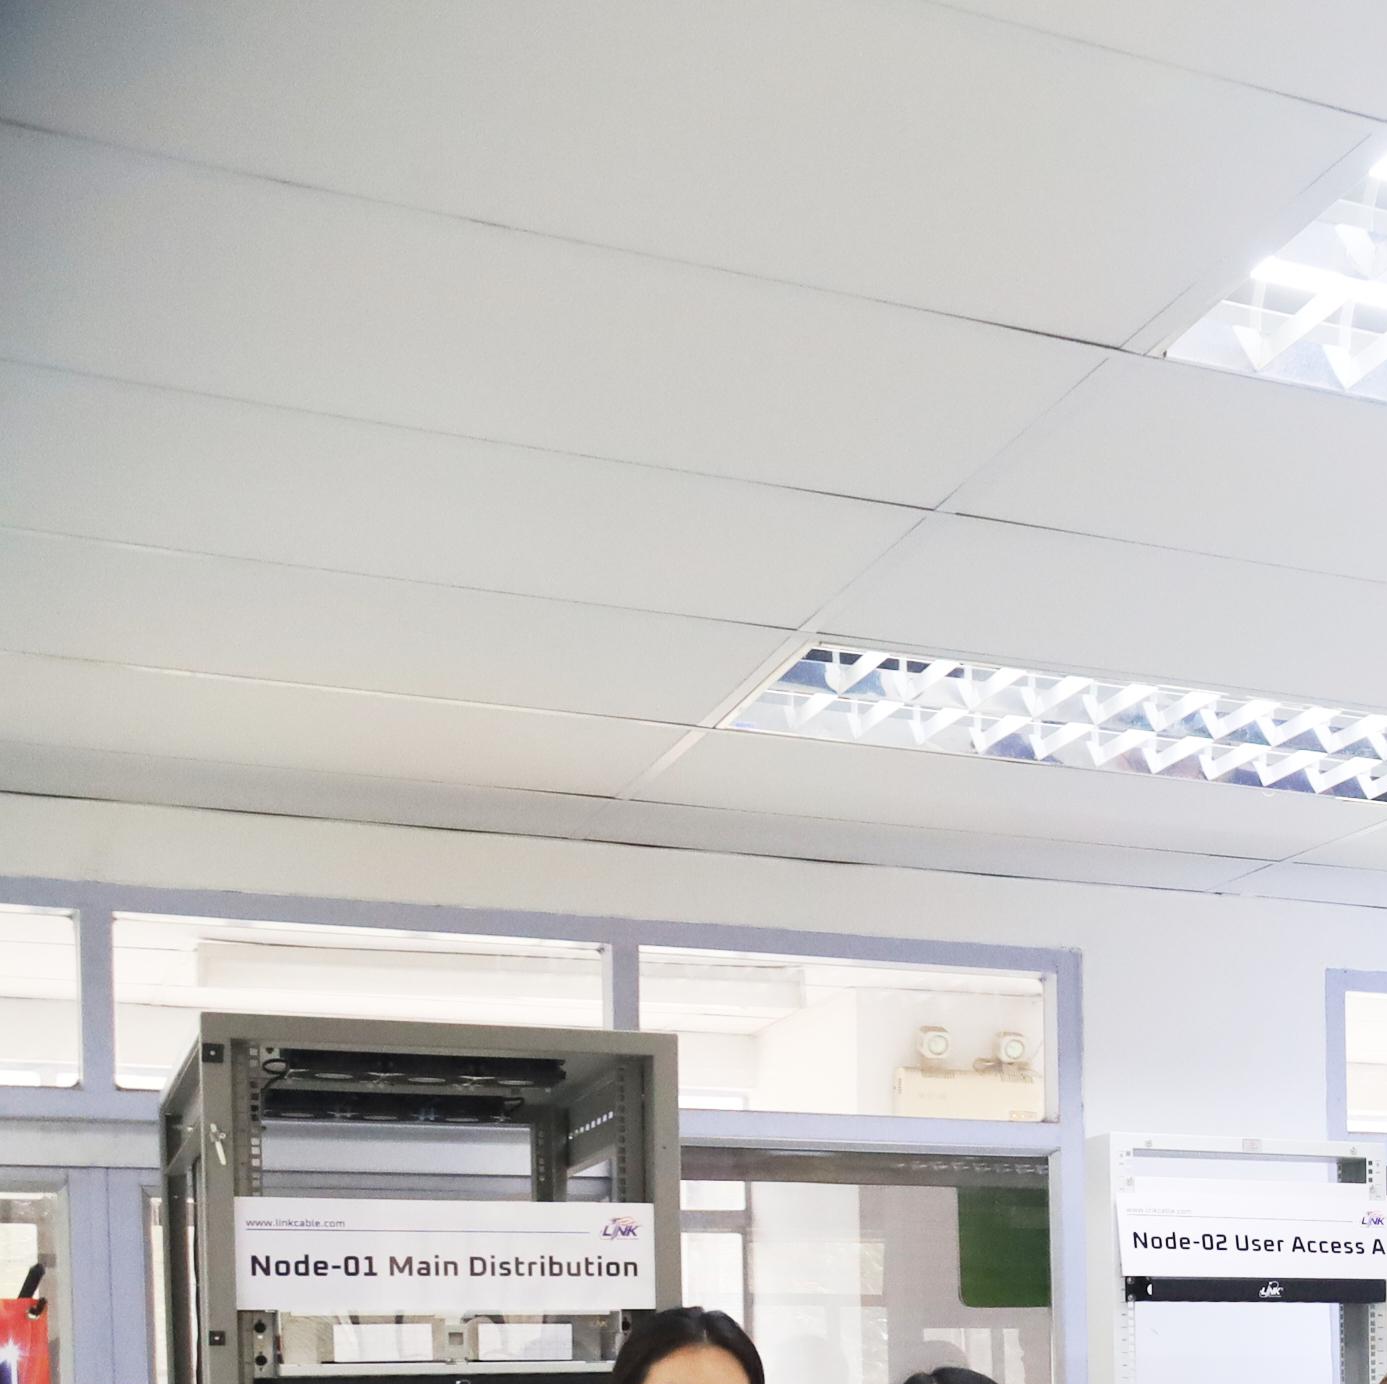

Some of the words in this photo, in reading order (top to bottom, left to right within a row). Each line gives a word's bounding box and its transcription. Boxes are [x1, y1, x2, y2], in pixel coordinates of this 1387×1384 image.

[245, 1218, 346, 1229] www.linkcable.com
[1132, 1231, 1228, 1252] Node-02
[1235, 1234, 1286, 1254] User
[1291, 1236, 1365, 1256] Access
[1371, 1238, 1386, 1256] A
[250, 1254, 378, 1278] Node-01
[388, 1254, 460, 1278] Main
[468, 1254, 640, 1279] Distribution
